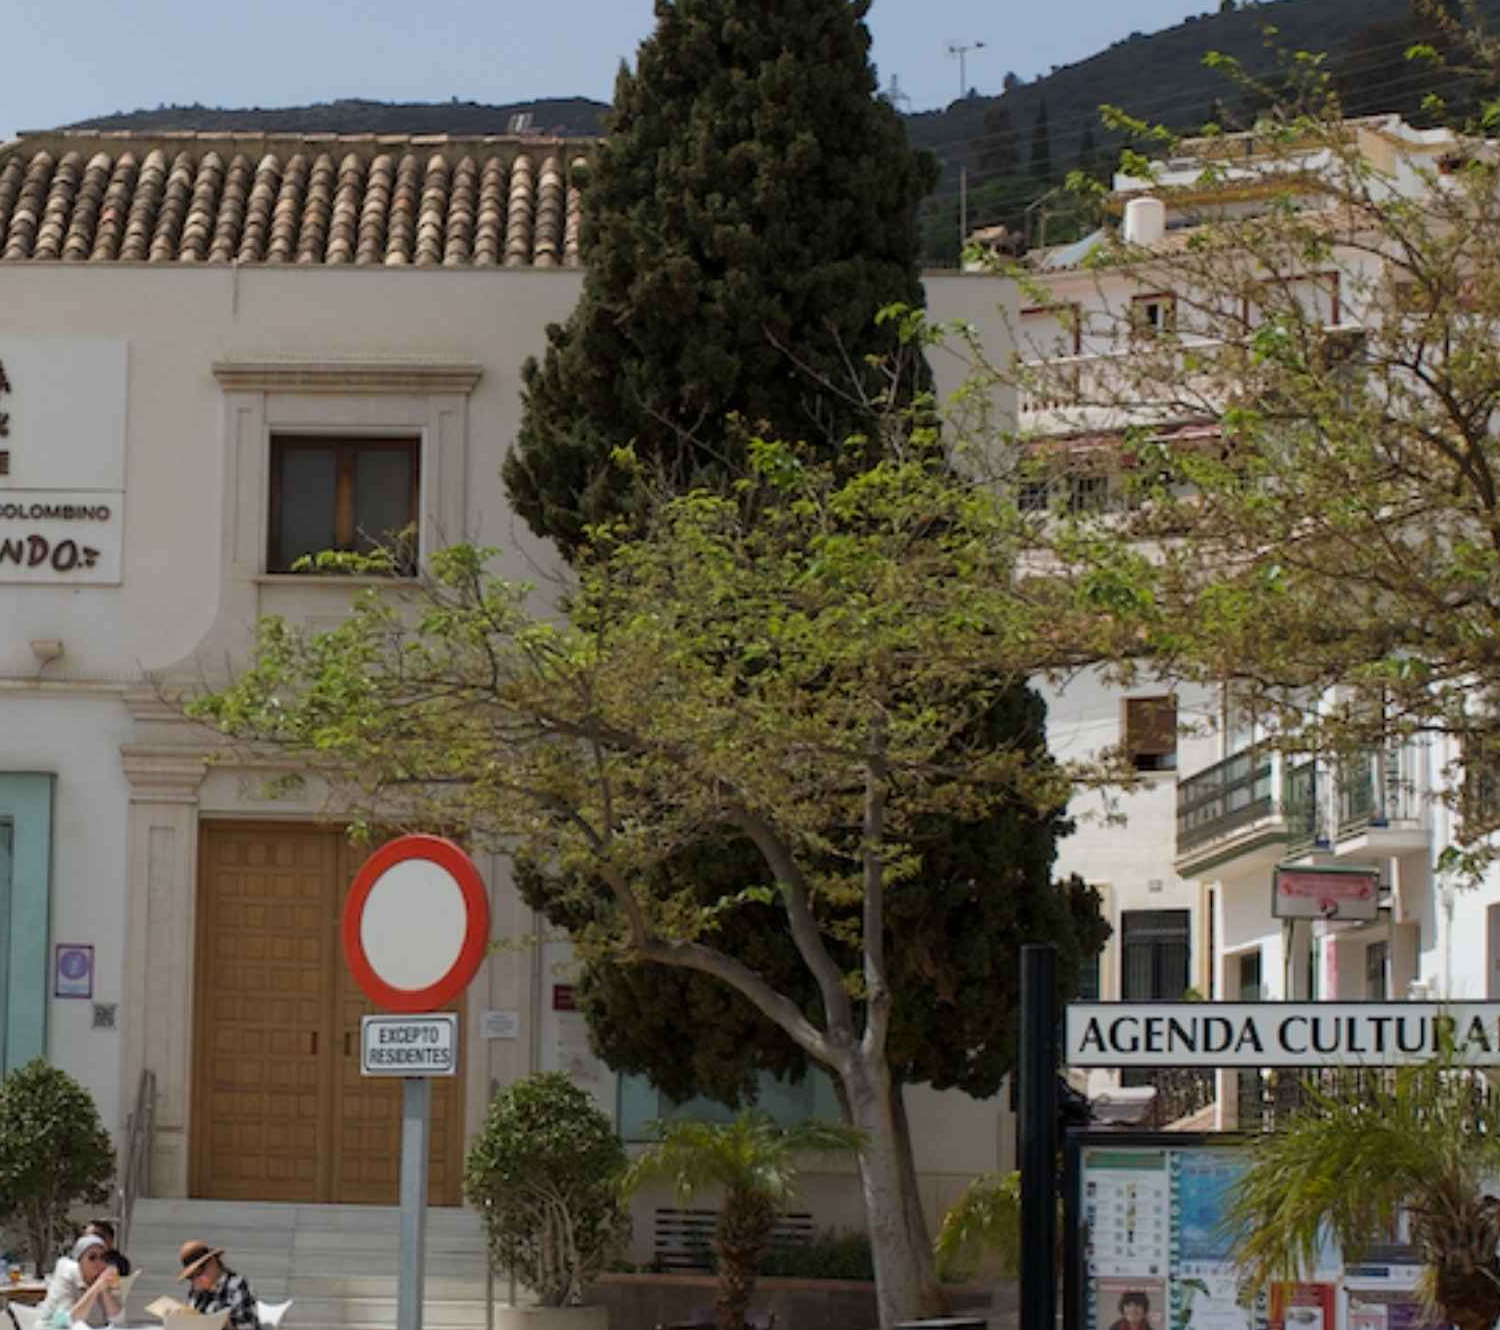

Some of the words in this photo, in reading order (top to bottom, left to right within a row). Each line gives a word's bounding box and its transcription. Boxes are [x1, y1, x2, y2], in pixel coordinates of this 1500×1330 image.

[379, 1026, 440, 1044] EXCEPTO
[1079, 1015, 1264, 1053] AGENDA
[368, 1047, 451, 1065] RESIDENTES
